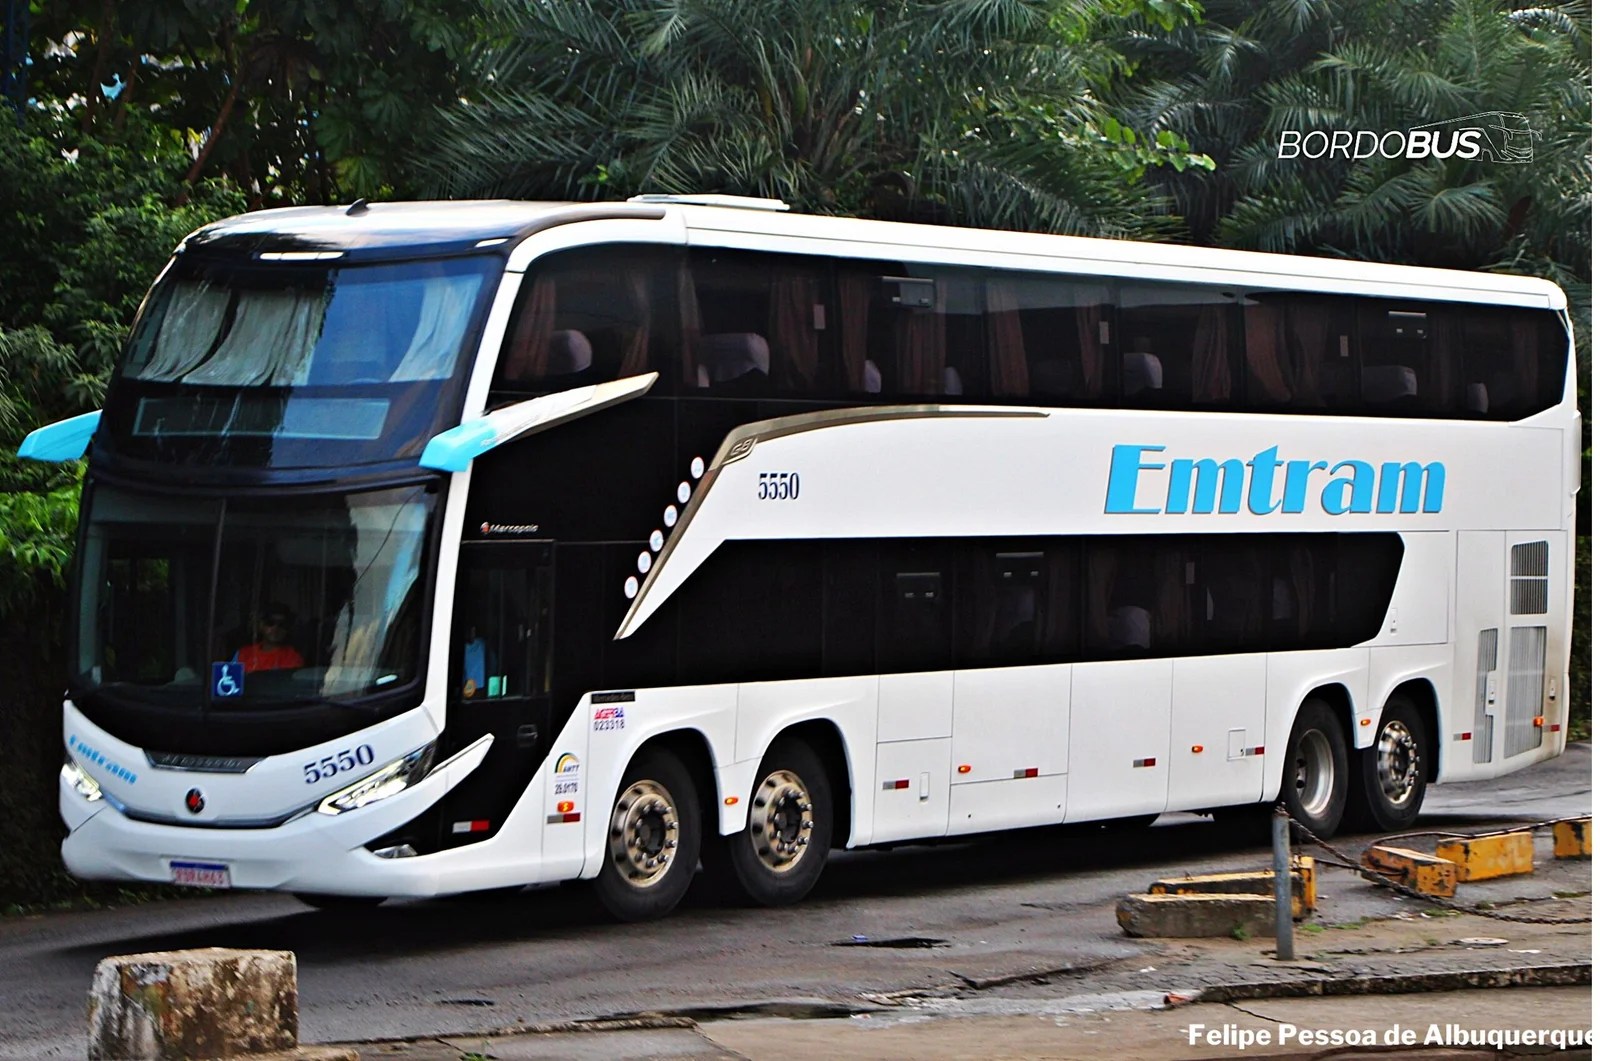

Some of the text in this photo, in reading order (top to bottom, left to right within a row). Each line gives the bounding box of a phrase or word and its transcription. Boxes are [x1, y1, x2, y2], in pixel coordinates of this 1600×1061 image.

[758, 472, 800, 500] 5550
[1103, 443, 1446, 516] Emtram
[303, 743, 376, 784] 5550
